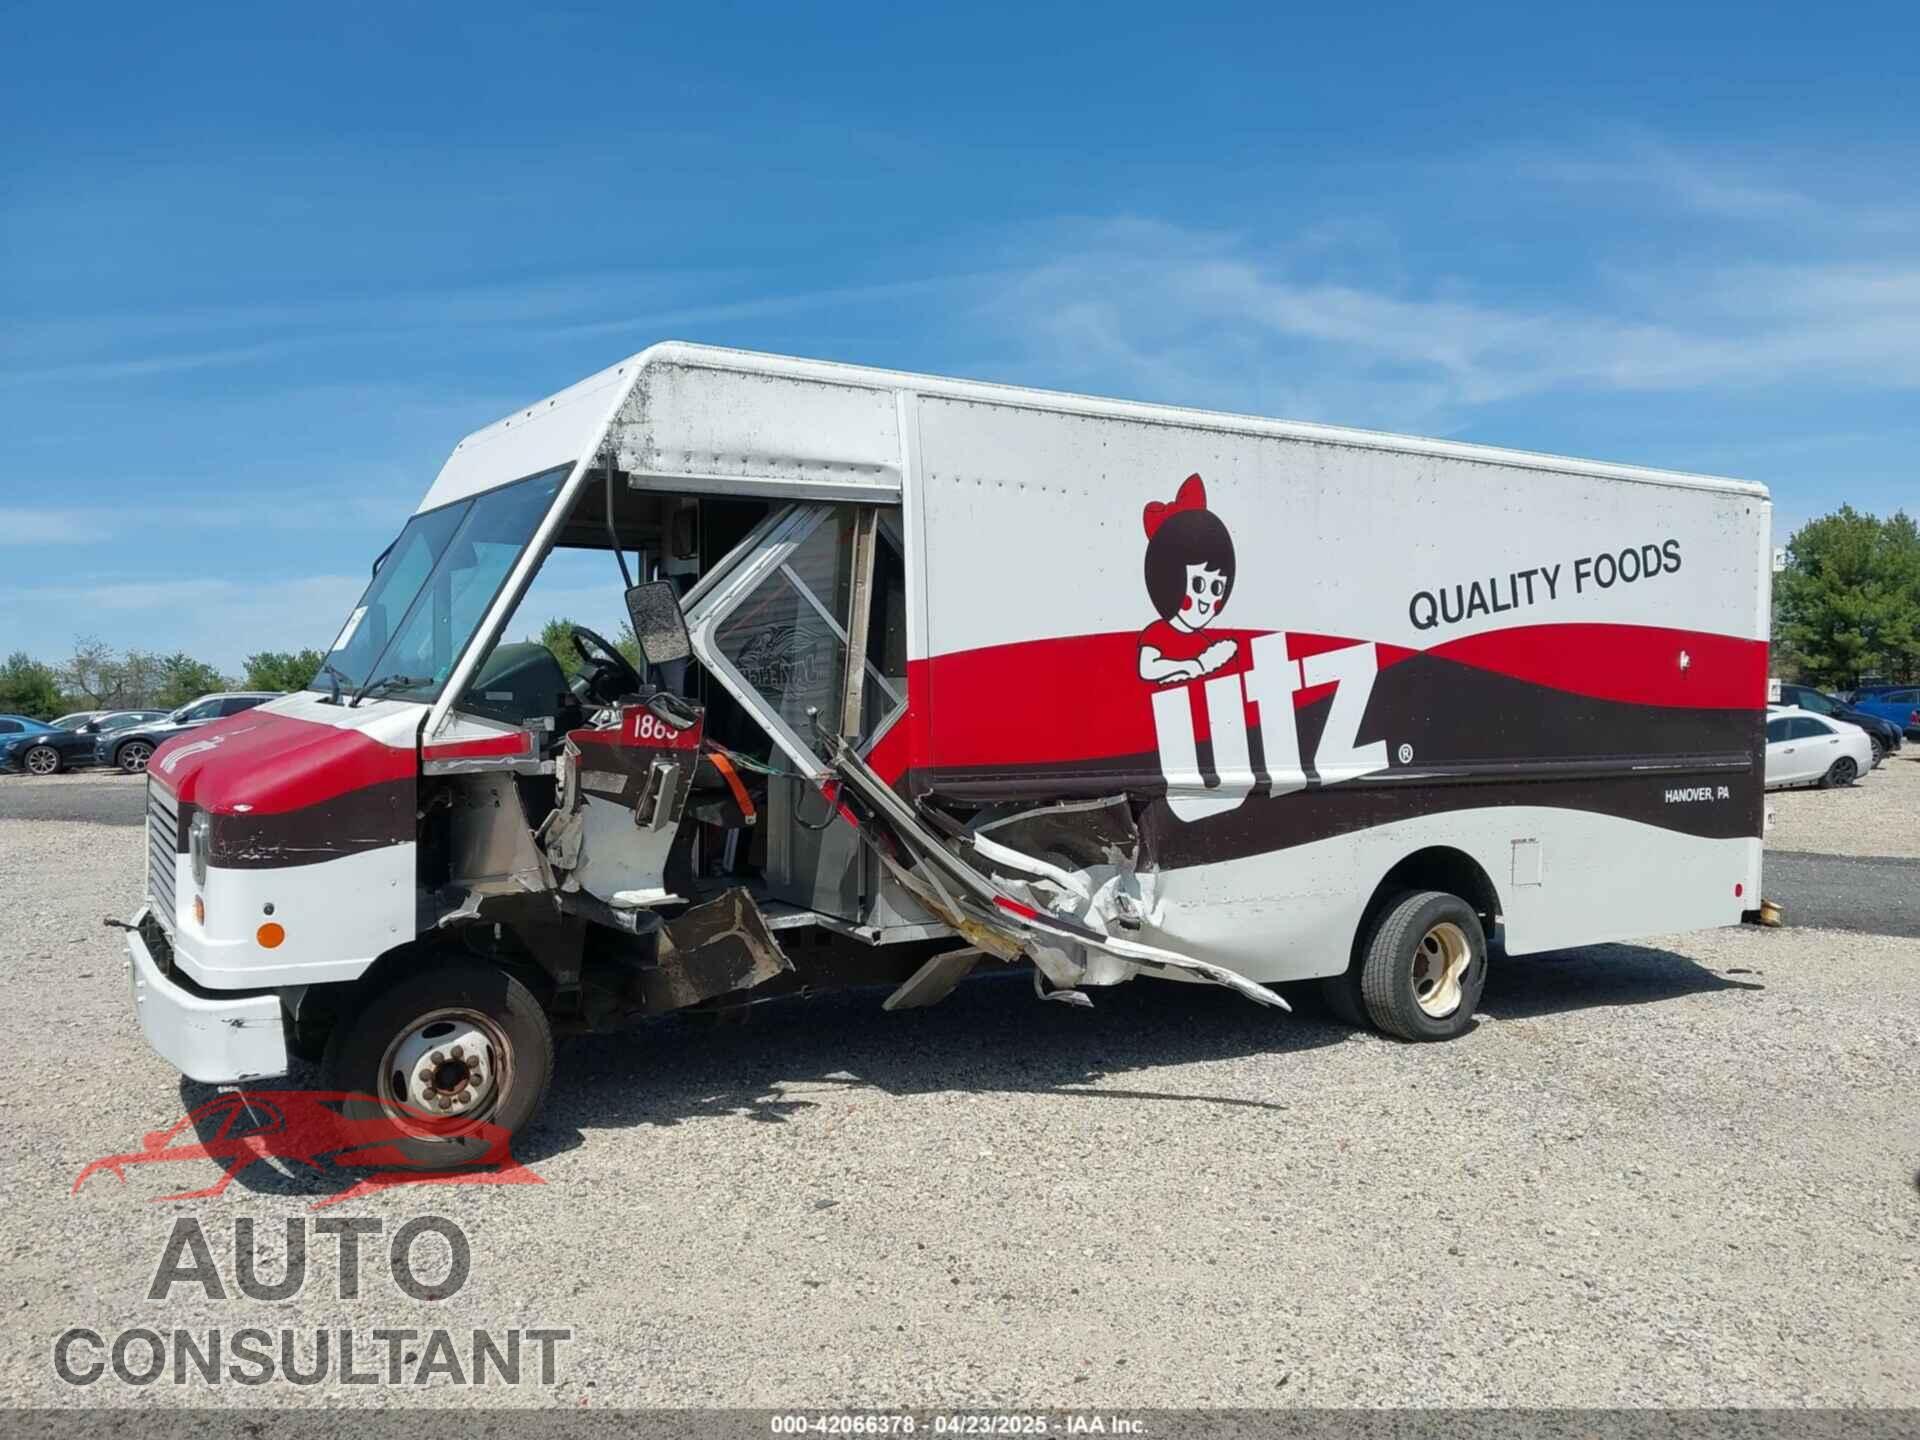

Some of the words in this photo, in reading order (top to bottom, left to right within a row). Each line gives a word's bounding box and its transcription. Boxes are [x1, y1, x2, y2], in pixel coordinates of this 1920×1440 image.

[1409, 564, 1561, 630] QUALITY
[1574, 539, 1682, 593] FOODS
[1665, 787, 1714, 803] HANOVER,
[1717, 785, 1729, 799] PA
